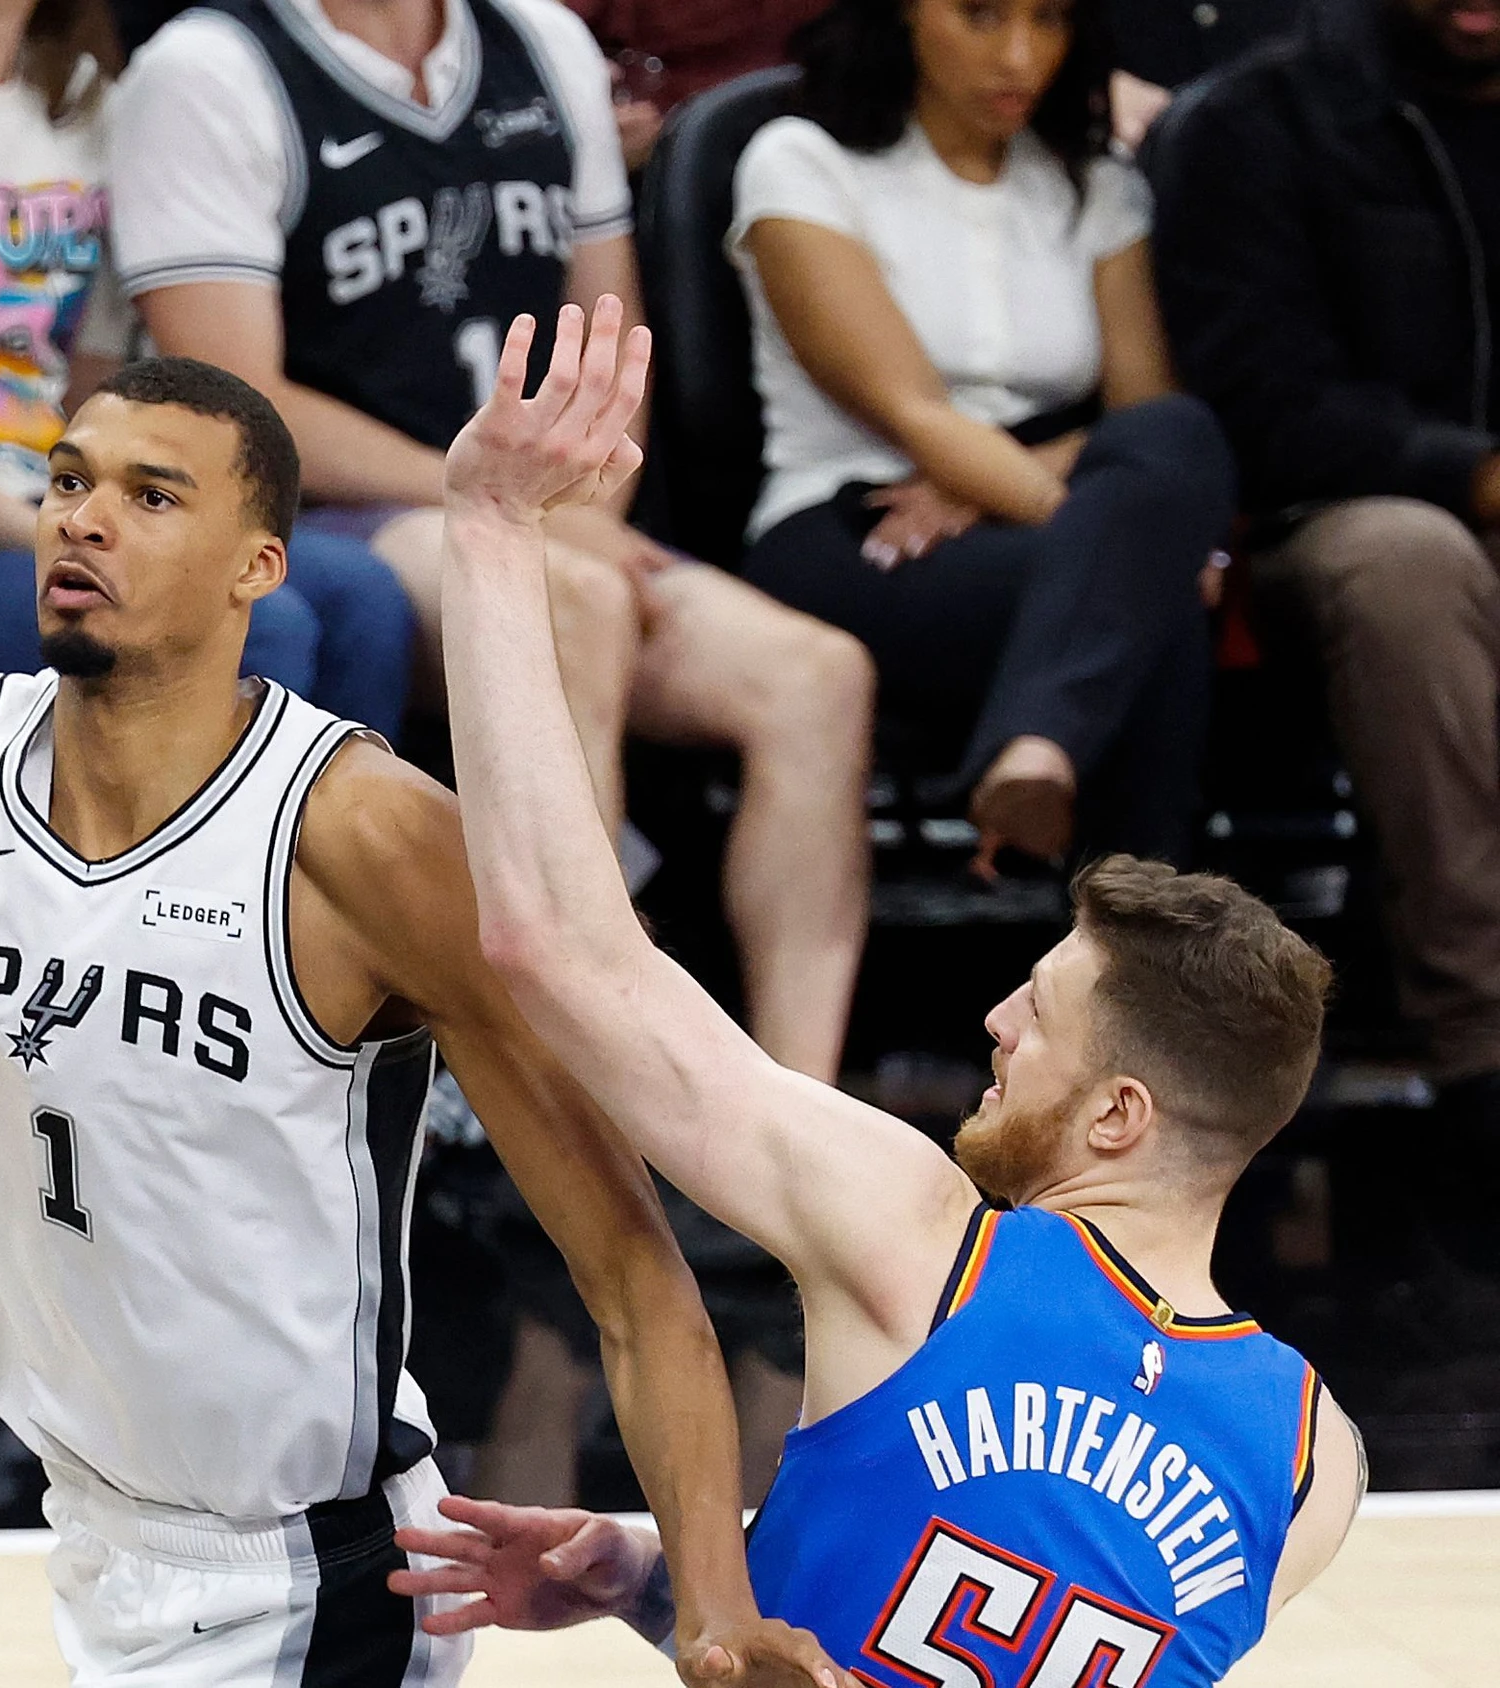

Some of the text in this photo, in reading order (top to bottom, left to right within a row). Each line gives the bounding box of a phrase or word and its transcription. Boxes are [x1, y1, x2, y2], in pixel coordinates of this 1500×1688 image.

[157, 901, 230, 926] LEDGER
[31, 1104, 93, 1242] 1
[907, 1382, 1245, 1616] HARTENSTEIN
